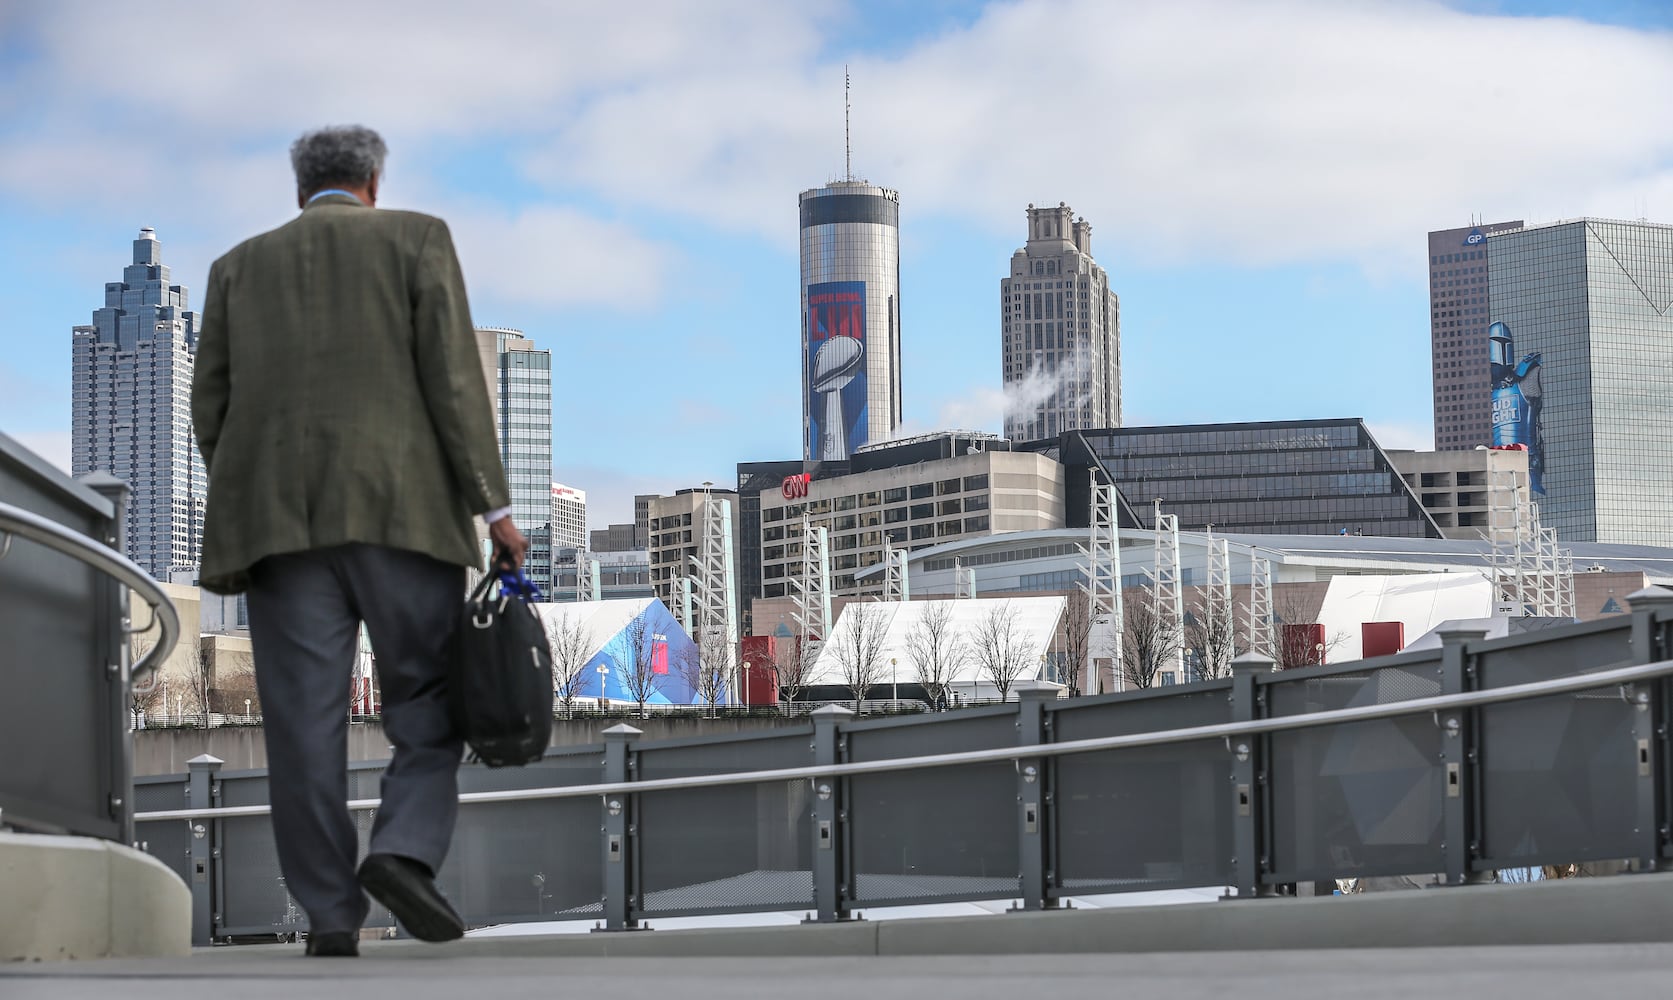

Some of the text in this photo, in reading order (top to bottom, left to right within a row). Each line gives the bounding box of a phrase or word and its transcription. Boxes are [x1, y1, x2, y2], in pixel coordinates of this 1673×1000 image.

[882, 188, 899, 203] WES
[1467, 234, 1482, 244] GP
[1492, 399, 1511, 411] UD
[1492, 407, 1519, 424] GHT
[782, 474, 809, 499] CNN
